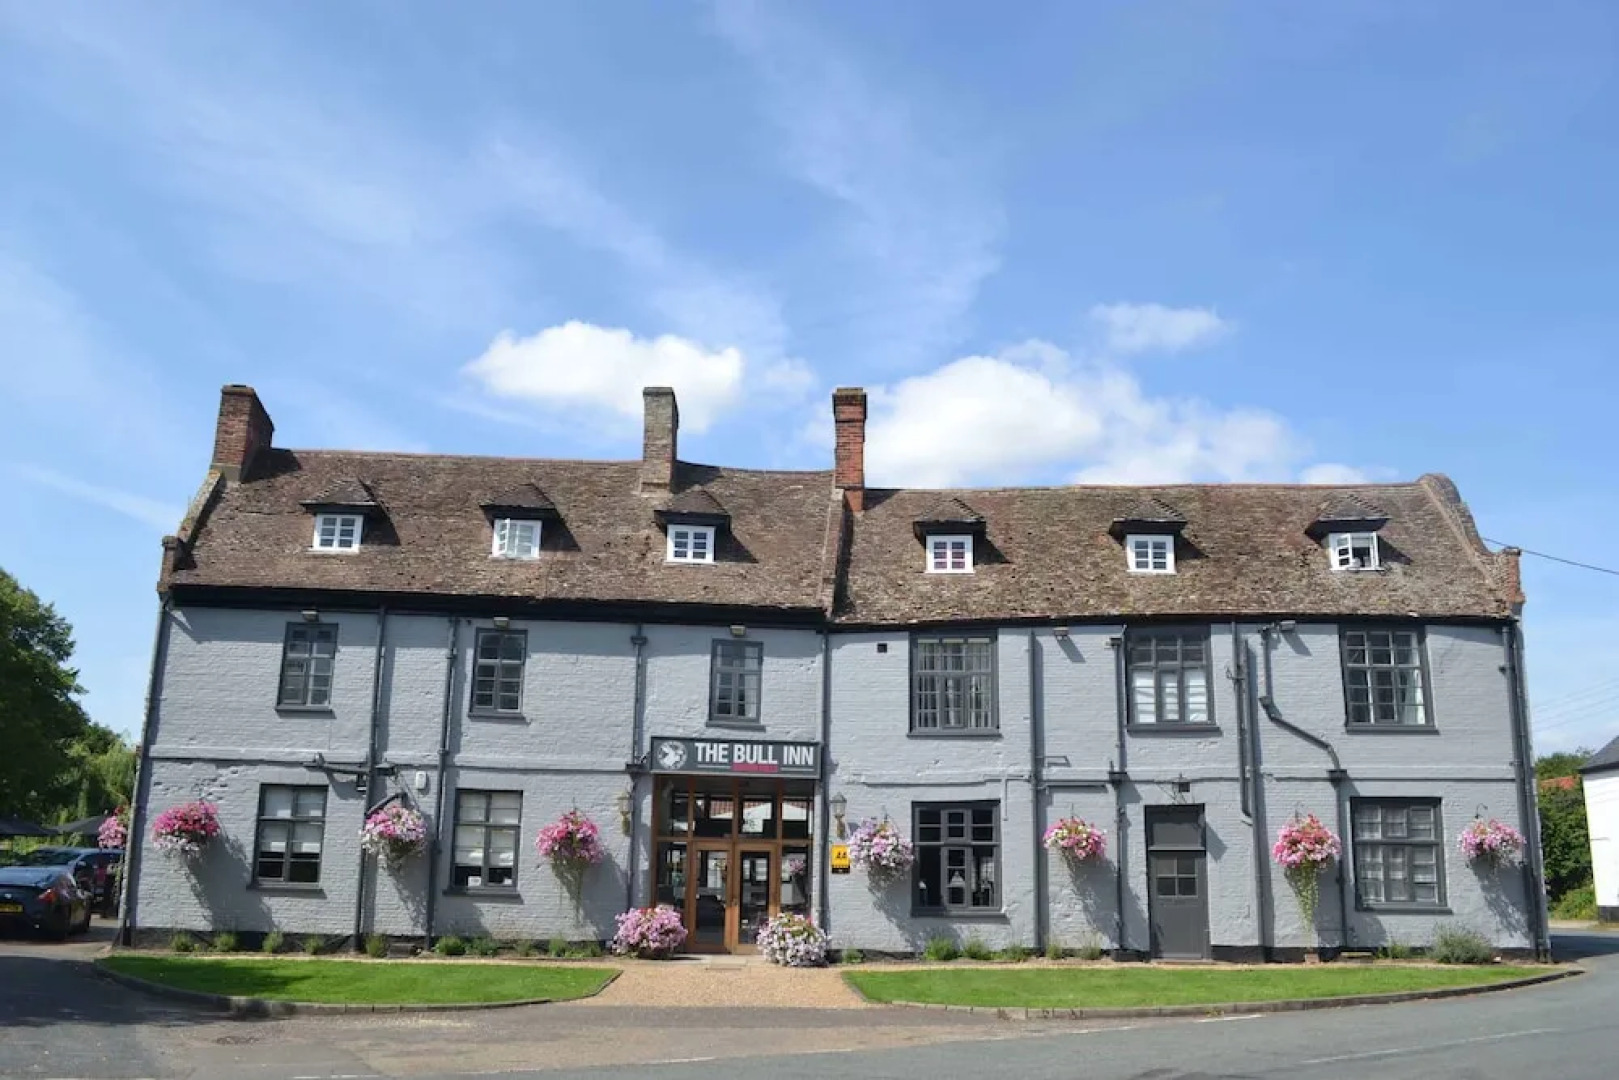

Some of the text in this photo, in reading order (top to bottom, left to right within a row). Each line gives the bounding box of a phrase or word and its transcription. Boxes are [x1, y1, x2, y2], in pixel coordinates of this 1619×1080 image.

[694, 742, 814, 765] THE BULL INN
